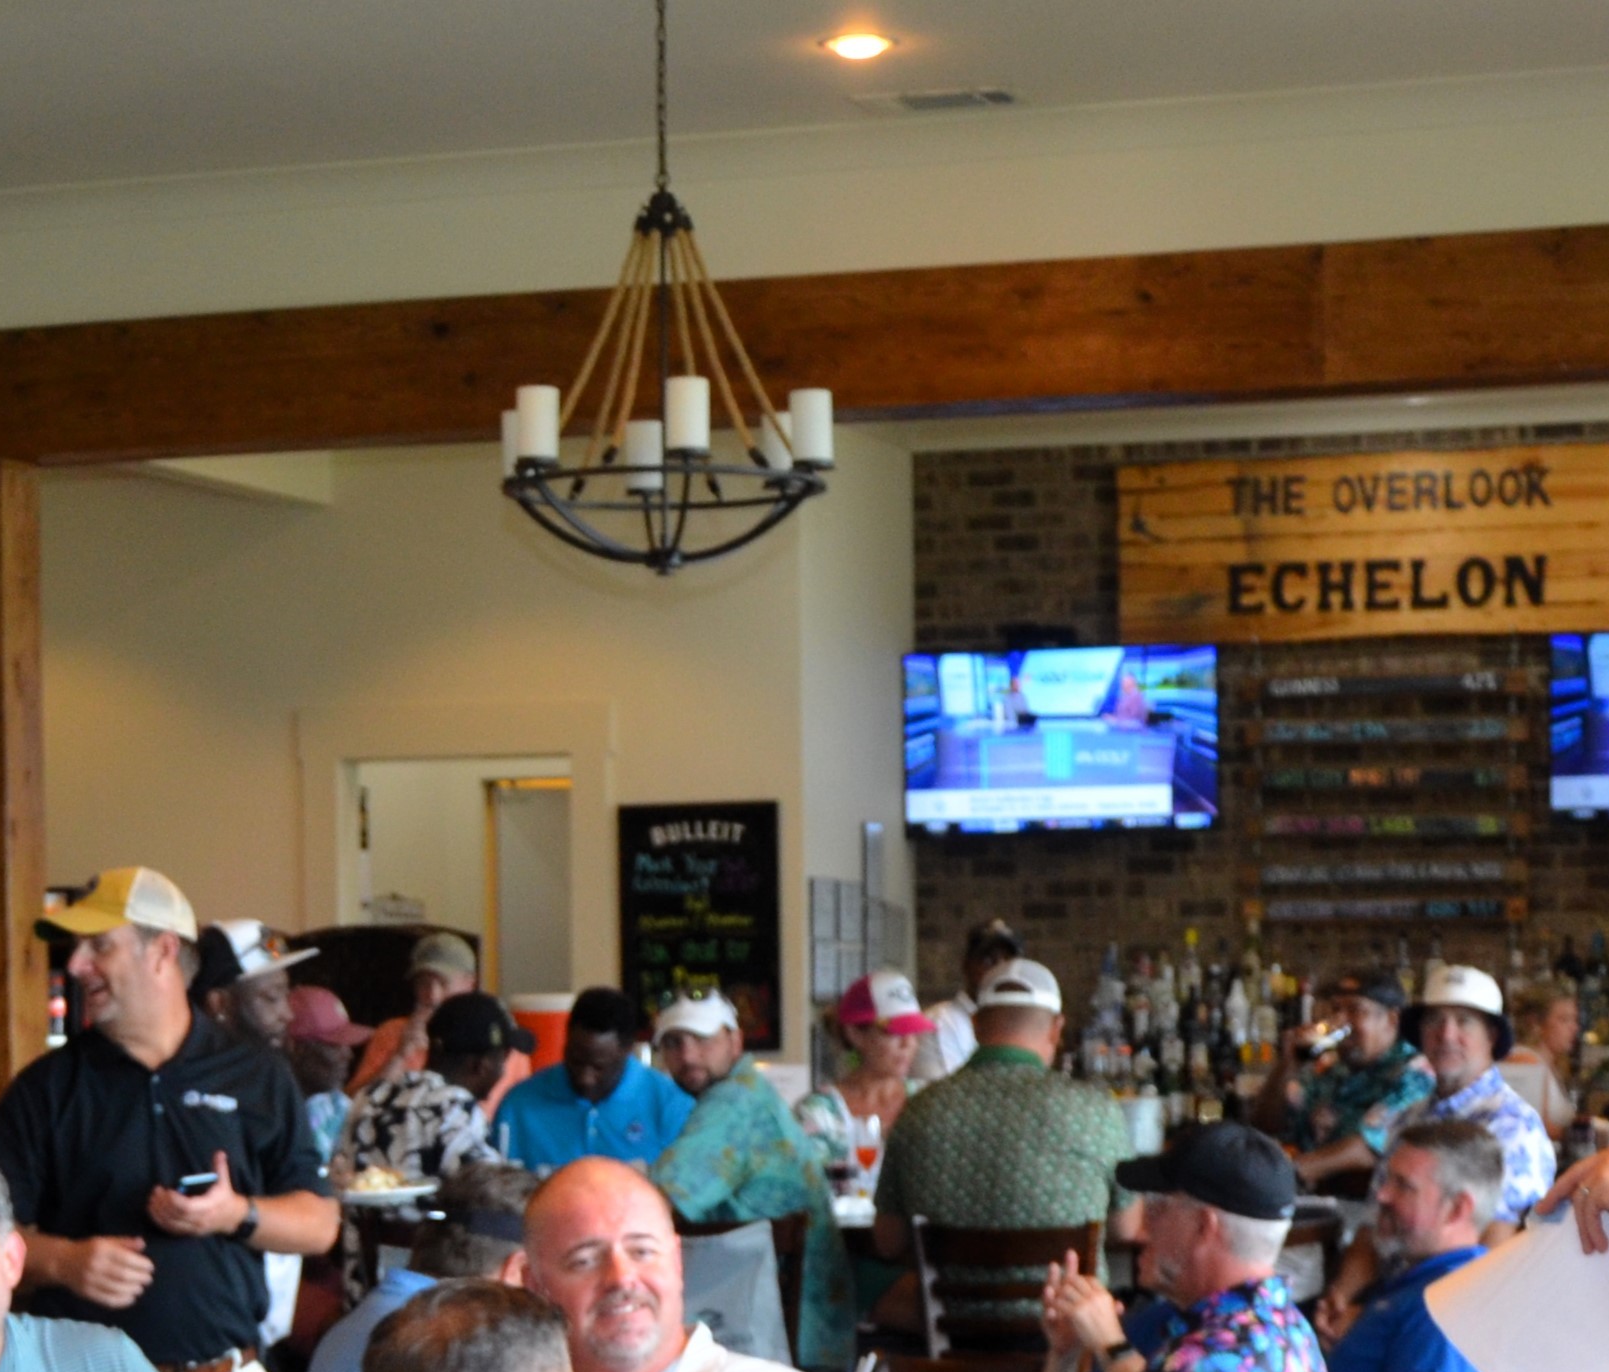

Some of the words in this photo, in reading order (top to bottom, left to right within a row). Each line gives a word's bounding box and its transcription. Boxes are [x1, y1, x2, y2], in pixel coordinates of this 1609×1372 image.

[1225, 474, 1307, 516] THE
[1332, 466, 1552, 513] OVERLOOK
[1227, 555, 1548, 616] ECHELON
[649, 820, 746, 847] BULLEIT
